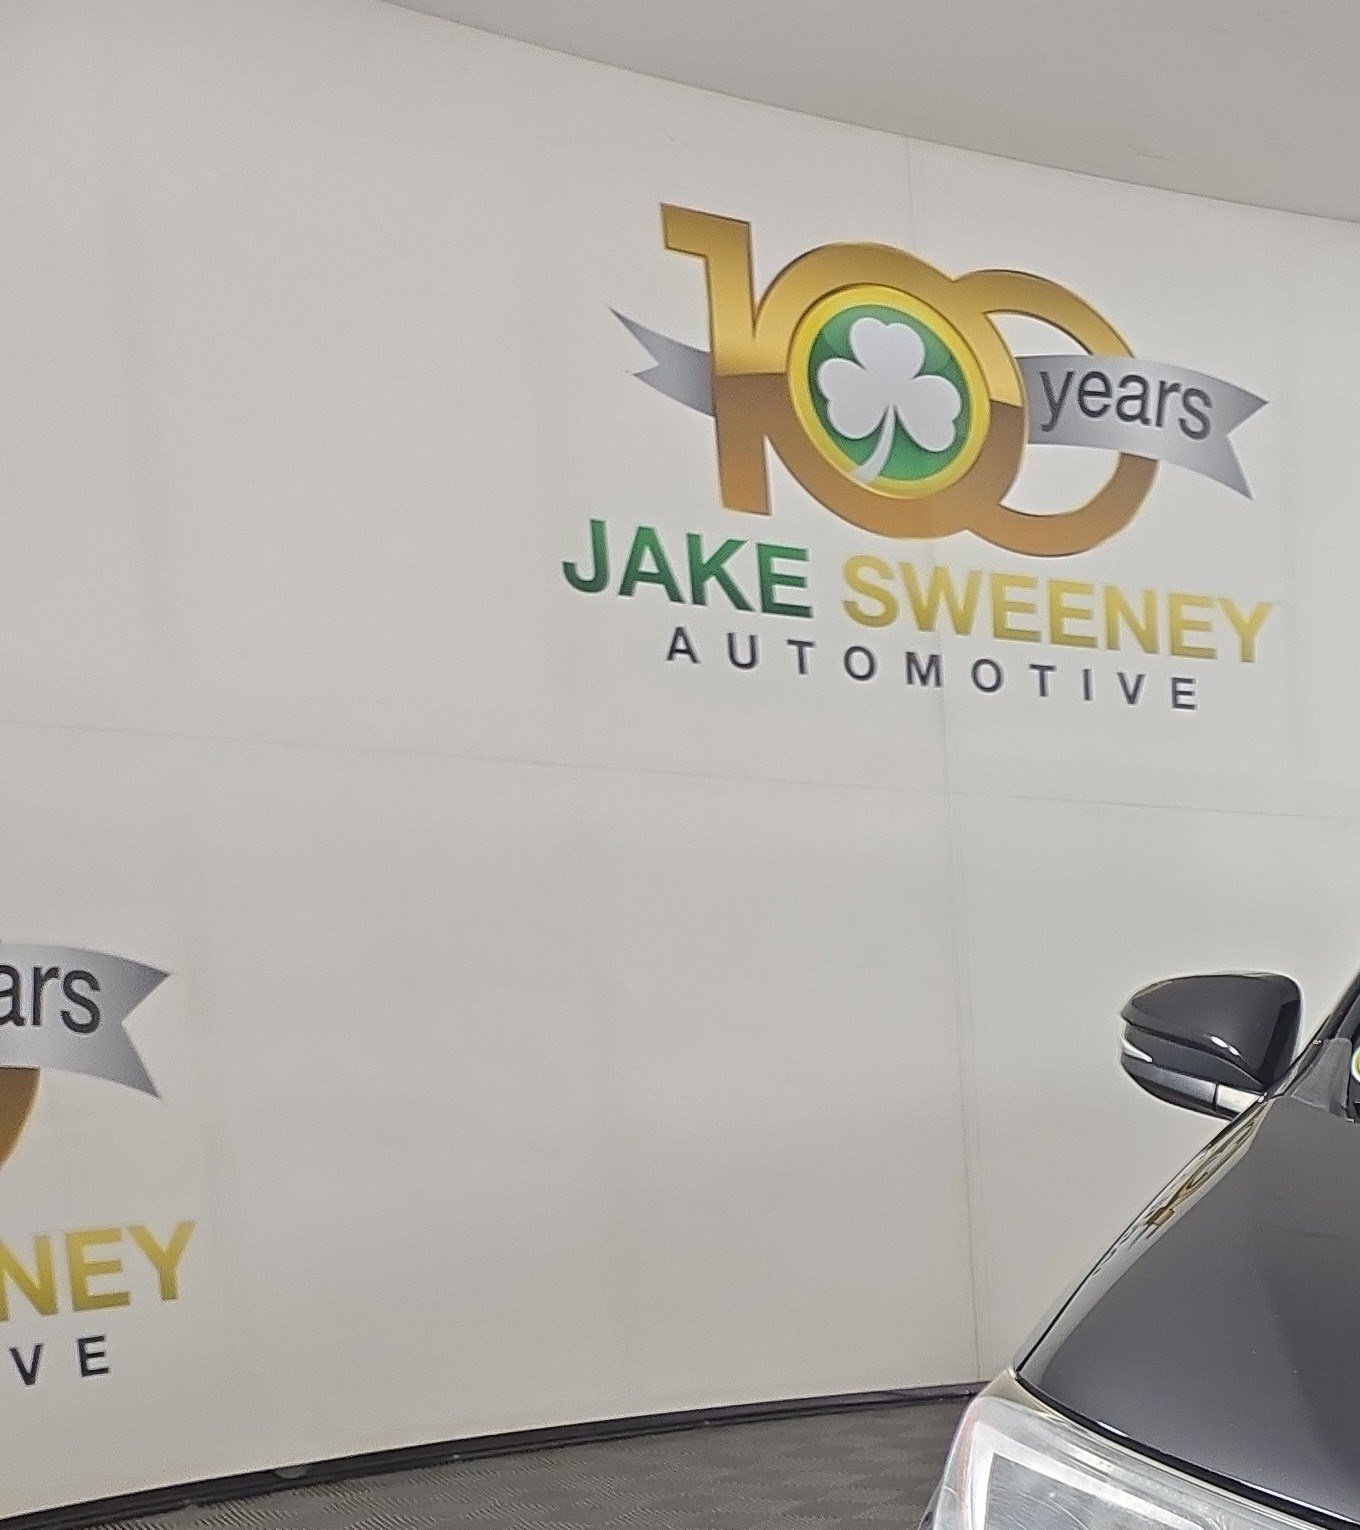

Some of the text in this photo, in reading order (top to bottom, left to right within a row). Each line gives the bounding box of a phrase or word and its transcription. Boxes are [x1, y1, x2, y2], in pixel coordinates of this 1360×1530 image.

[660, 203, 1213, 557] 100 years
[562, 518, 1274, 664] JAKE SWEENEY
[666, 627, 1198, 711] AUTOMOTIVE
